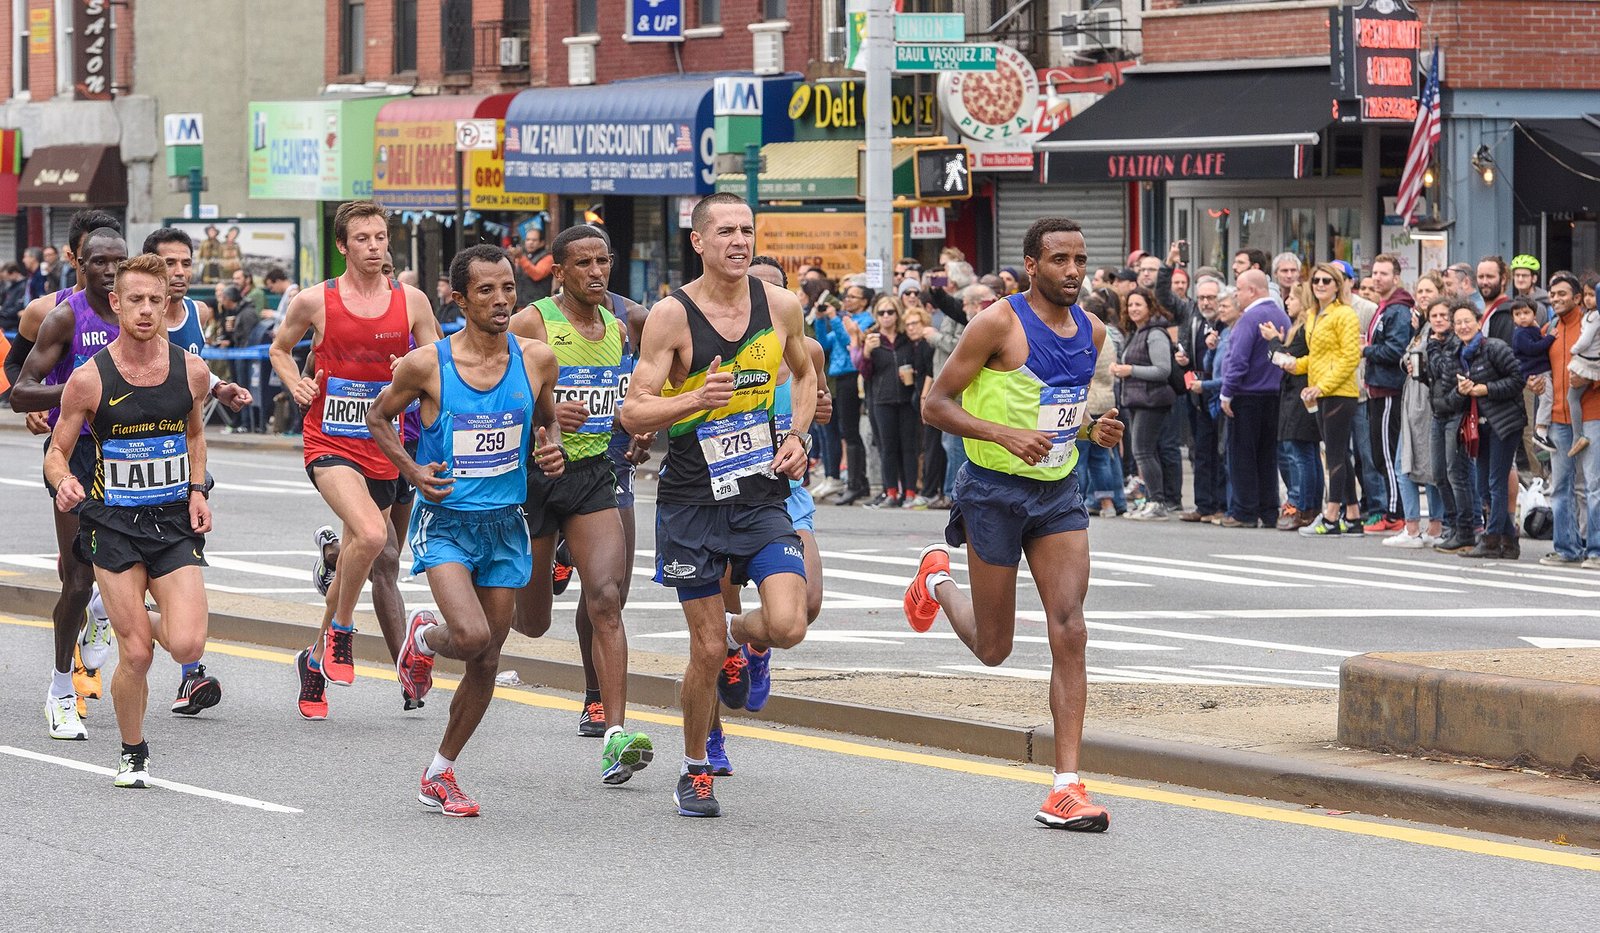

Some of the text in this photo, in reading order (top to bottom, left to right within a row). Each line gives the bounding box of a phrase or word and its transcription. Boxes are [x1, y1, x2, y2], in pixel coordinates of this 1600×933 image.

[637, 15, 678, 32] & UP
[899, 17, 944, 38] UNION
[898, 48, 995, 63] RAUL VASQUEZ JR.
[934, 62, 960, 70] PLACE
[814, 81, 857, 129] Deli
[959, 116, 1029, 140] PIZZA
[520, 124, 541, 155] MZ
[541, 124, 585, 155] FAMILY
[586, 123, 651, 156] DISCOUNT
[270, 138, 319, 175] CLEANERS
[1107, 152, 1226, 178] STATION CAFE
[476, 194, 498, 205] OPEN
[500, 194, 510, 205] 24
[511, 194, 541, 206] HOURS
[81, 330, 108, 347] NRC
[1057, 406, 1078, 428] 249
[112, 422, 155, 436] Fiamme
[475, 431, 506, 453] 259
[721, 431, 753, 457] 279
[109, 456, 186, 489] LALLI
[719, 484, 732, 495] 279
